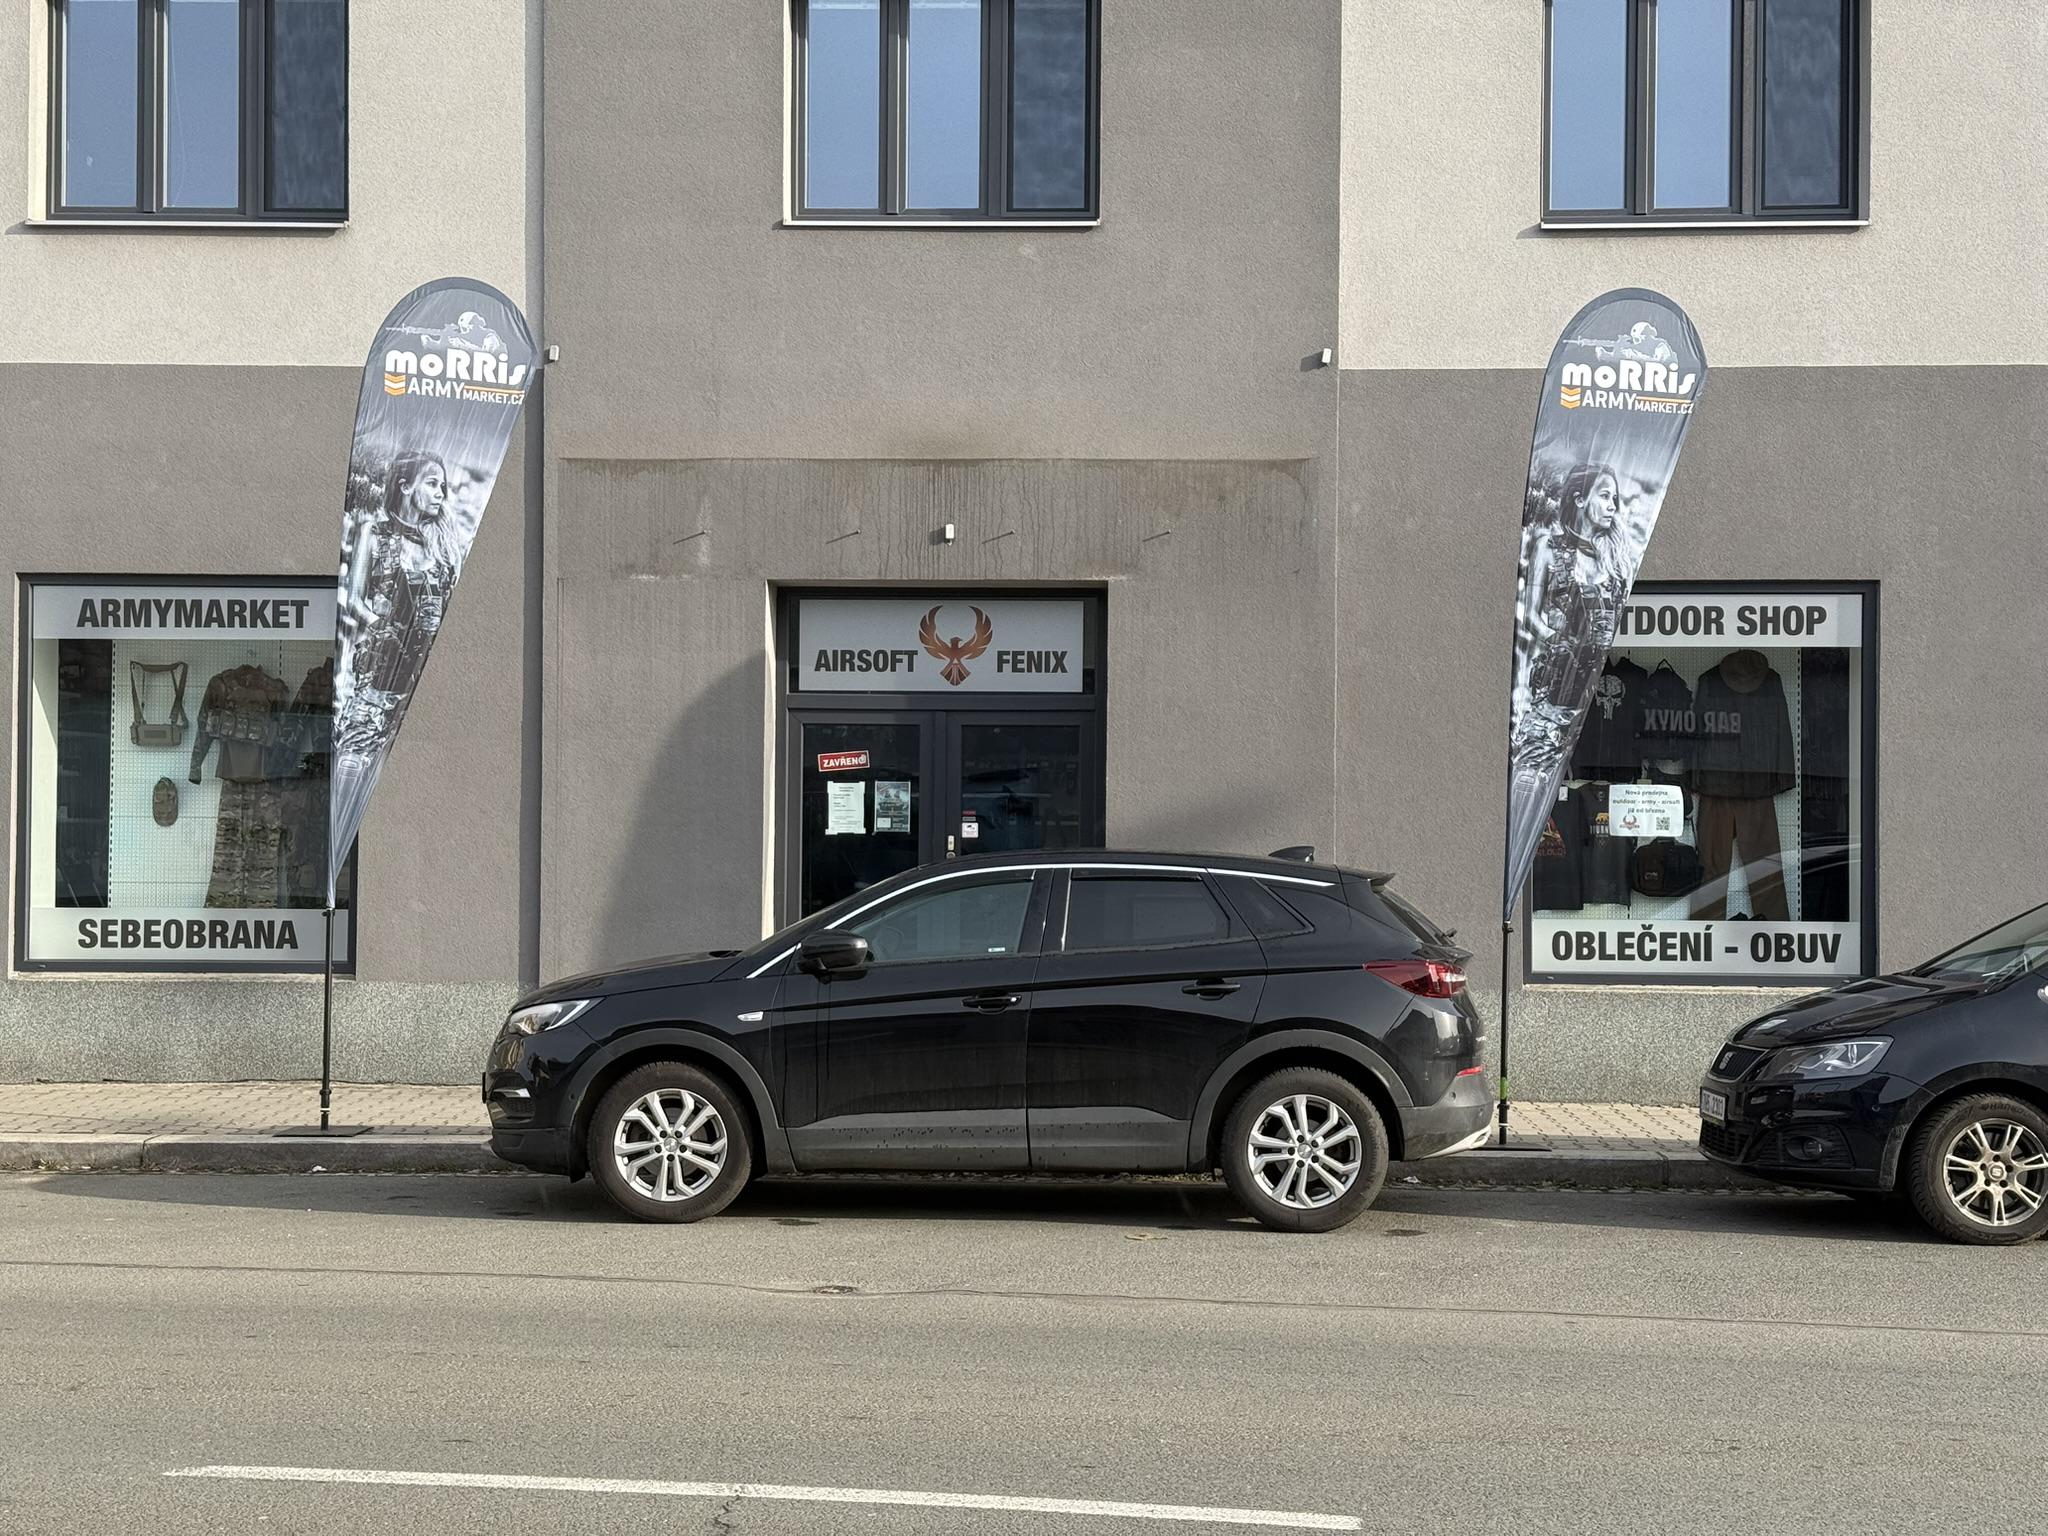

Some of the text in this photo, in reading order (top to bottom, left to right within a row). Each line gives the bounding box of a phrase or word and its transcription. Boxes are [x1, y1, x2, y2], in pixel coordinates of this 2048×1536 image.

[385, 348, 526, 385] moRRis
[1562, 359, 1696, 395] moRRis
[76, 598, 310, 629] ARMYMARKET
[1618, 604, 1828, 637] TDOOR SHOP
[814, 649, 1069, 674] AIRSOFT FENIX
[822, 753, 867, 768] ZAVŘENO
[77, 918, 299, 950] SEBEOBRANA
[1551, 923, 1714, 962] OBLEČENÍ
[1749, 931, 1842, 963] OBUV
